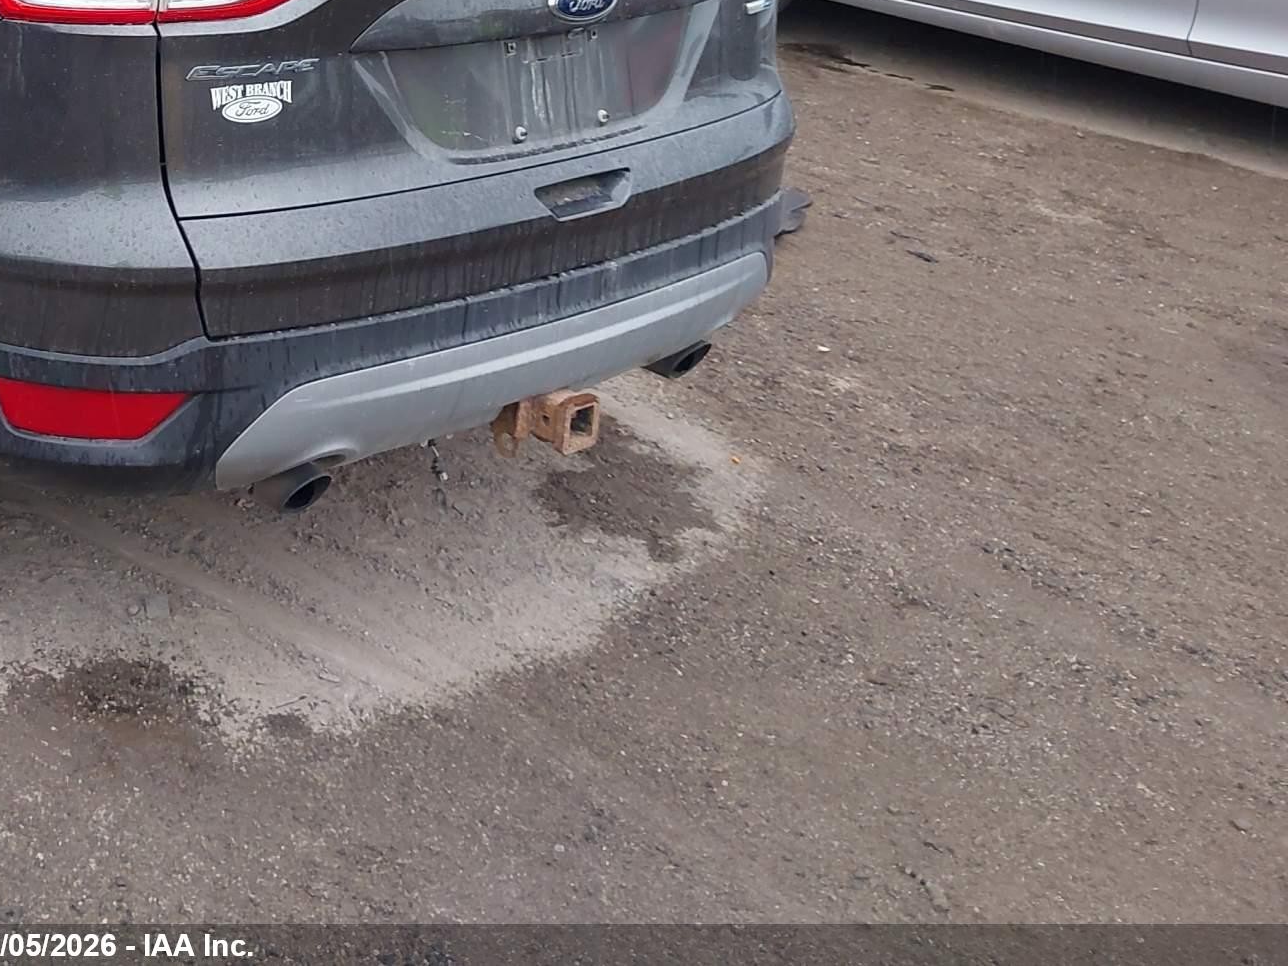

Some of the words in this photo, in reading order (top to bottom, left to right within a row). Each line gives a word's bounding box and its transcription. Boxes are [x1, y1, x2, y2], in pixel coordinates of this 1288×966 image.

[185, 58, 320, 81] ESCAPE
[210, 84, 244, 111] WEST
[245, 80, 293, 104] BRANCH
[234, 100, 270, 117] Ford
